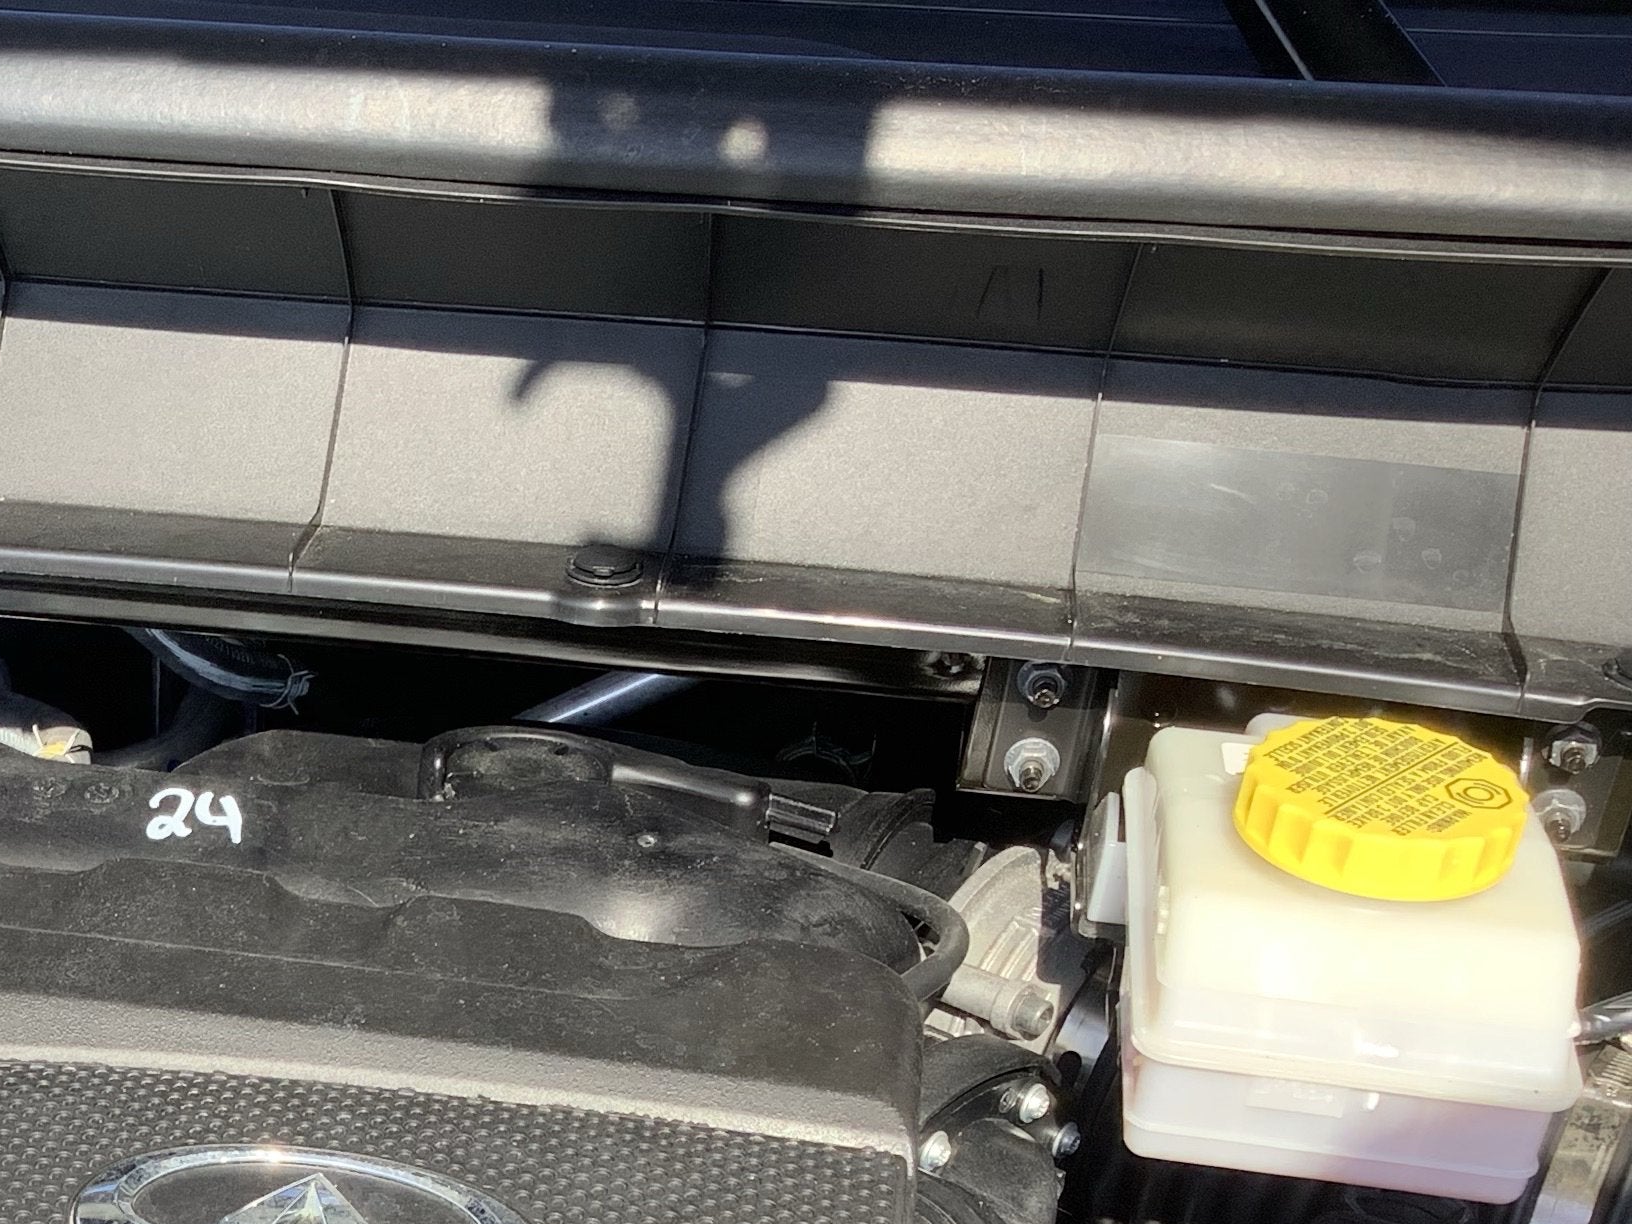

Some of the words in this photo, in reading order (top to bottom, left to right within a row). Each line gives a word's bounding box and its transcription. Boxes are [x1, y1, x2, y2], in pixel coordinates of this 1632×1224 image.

[1380, 724, 1416, 743] AVANT
[1439, 744, 1472, 761] FLUID
[1408, 771, 1424, 779] A
[1415, 757, 1448, 775] FROM
[1330, 774, 1380, 799] NETTOYER
[1376, 776, 1416, 796] SEALED
[1316, 796, 1338, 807] LE
[1374, 803, 1391, 813] 3
[1382, 794, 1408, 808] DOT
[1412, 793, 1440, 808] CAP
[146, 787, 243, 844] 24
[1346, 808, 1384, 827] BRAKE
[1380, 805, 1420, 825] BEFORE
[1419, 801, 1456, 819] CLEAN
[1390, 816, 1428, 835] FILLER
